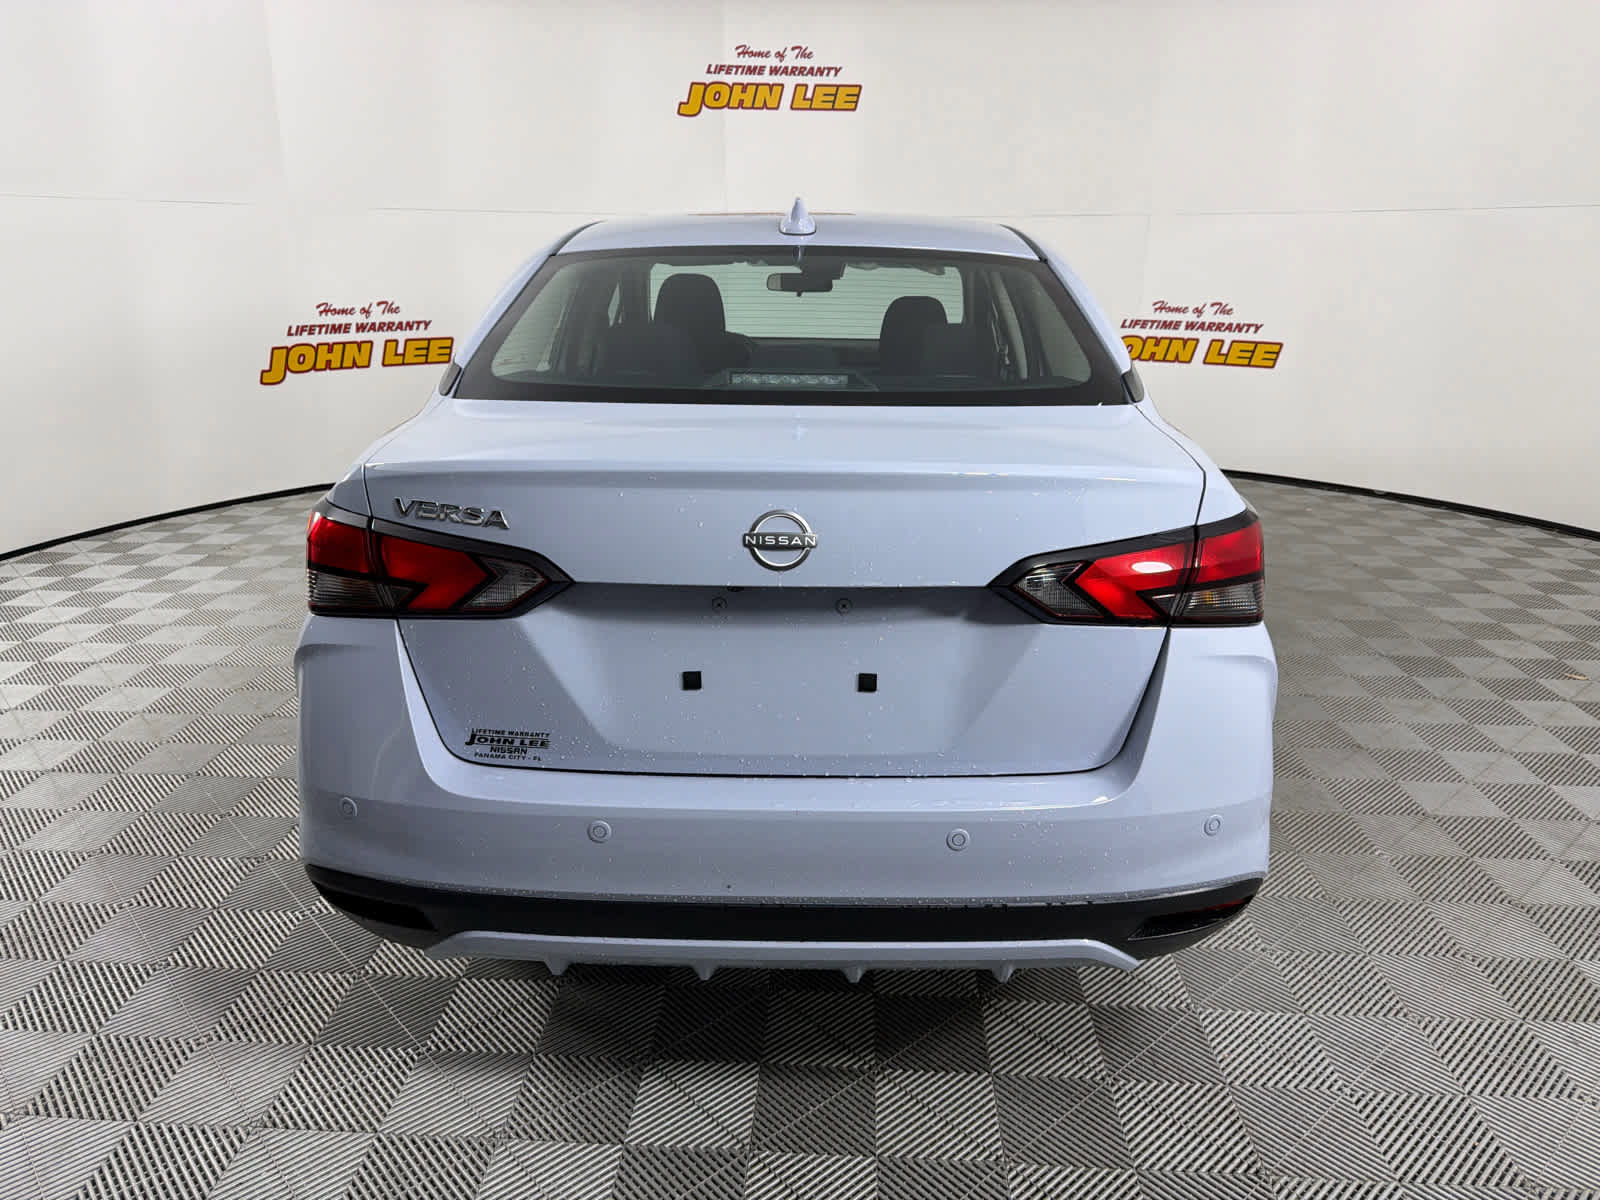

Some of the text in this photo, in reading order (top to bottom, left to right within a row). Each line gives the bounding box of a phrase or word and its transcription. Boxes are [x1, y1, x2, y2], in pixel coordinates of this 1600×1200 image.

[735, 44, 813, 62] Home of The
[706, 64, 842, 77] LIFETIME WARRANTY
[677, 81, 862, 117] JOHN LEE
[315, 301, 400, 319] Home of The
[1152, 300, 1234, 318] Home of The
[287, 320, 432, 336] LIFETIME WARRANTY
[1120, 319, 1264, 334] LIFETIME WARRANTY
[1120, 335, 1284, 368] OHN LEE
[260, 337, 454, 385] JOHN LEE
[393, 496, 510, 530] VERSA
[745, 535, 816, 546] NISSAN
[465, 733, 549, 749] JOHN LEE
[474, 752, 506, 760] PANAMA
[489, 746, 528, 755] NISSAN
